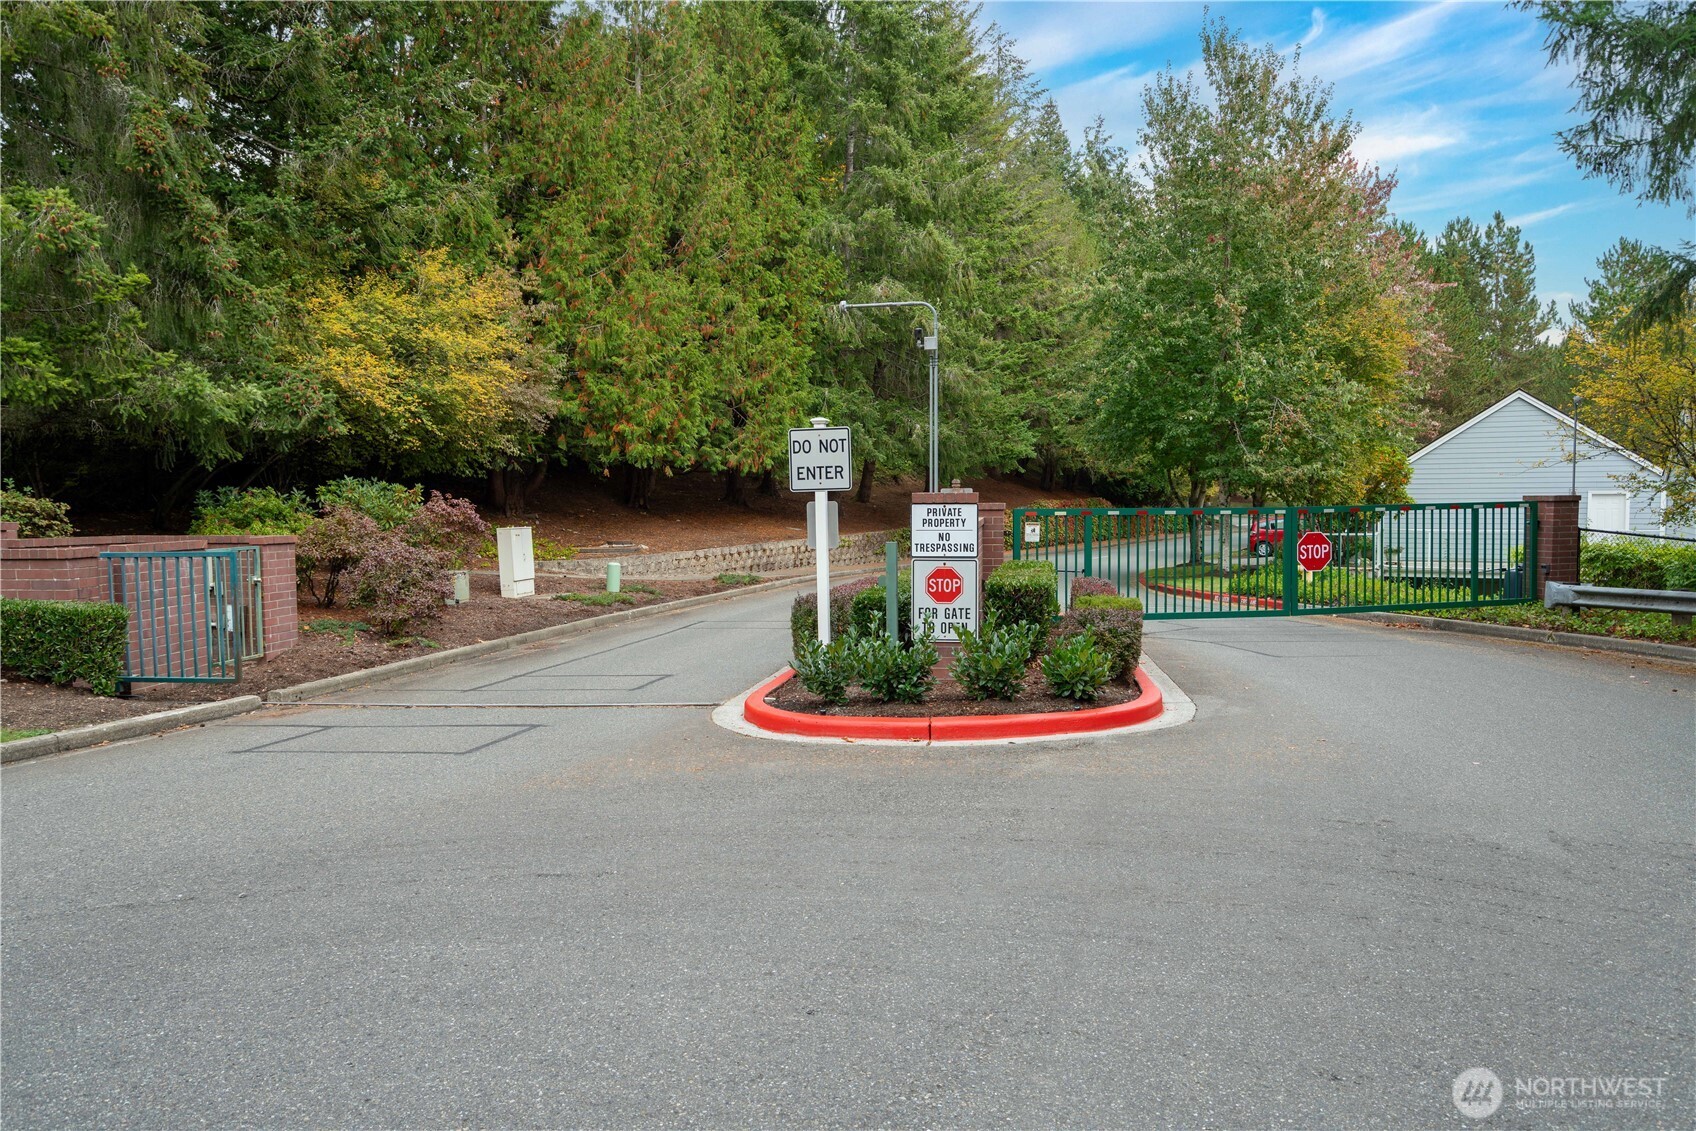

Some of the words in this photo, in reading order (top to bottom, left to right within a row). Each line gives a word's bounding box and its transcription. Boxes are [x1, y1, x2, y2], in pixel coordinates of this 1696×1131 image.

[793, 440, 812, 454] DO
[819, 438, 847, 453] NOT
[797, 465, 844, 481] ENTER
[926, 507, 962, 517] PRIVATE
[922, 518, 967, 528] PROPERTY
[938, 532, 951, 542] NO
[914, 543, 975, 553] TRESPASSING
[1299, 544, 1330, 560] STOP
[928, 578, 961, 593] STOP
[944, 607, 971, 620] GATE
[940, 621, 968, 634] OPN
